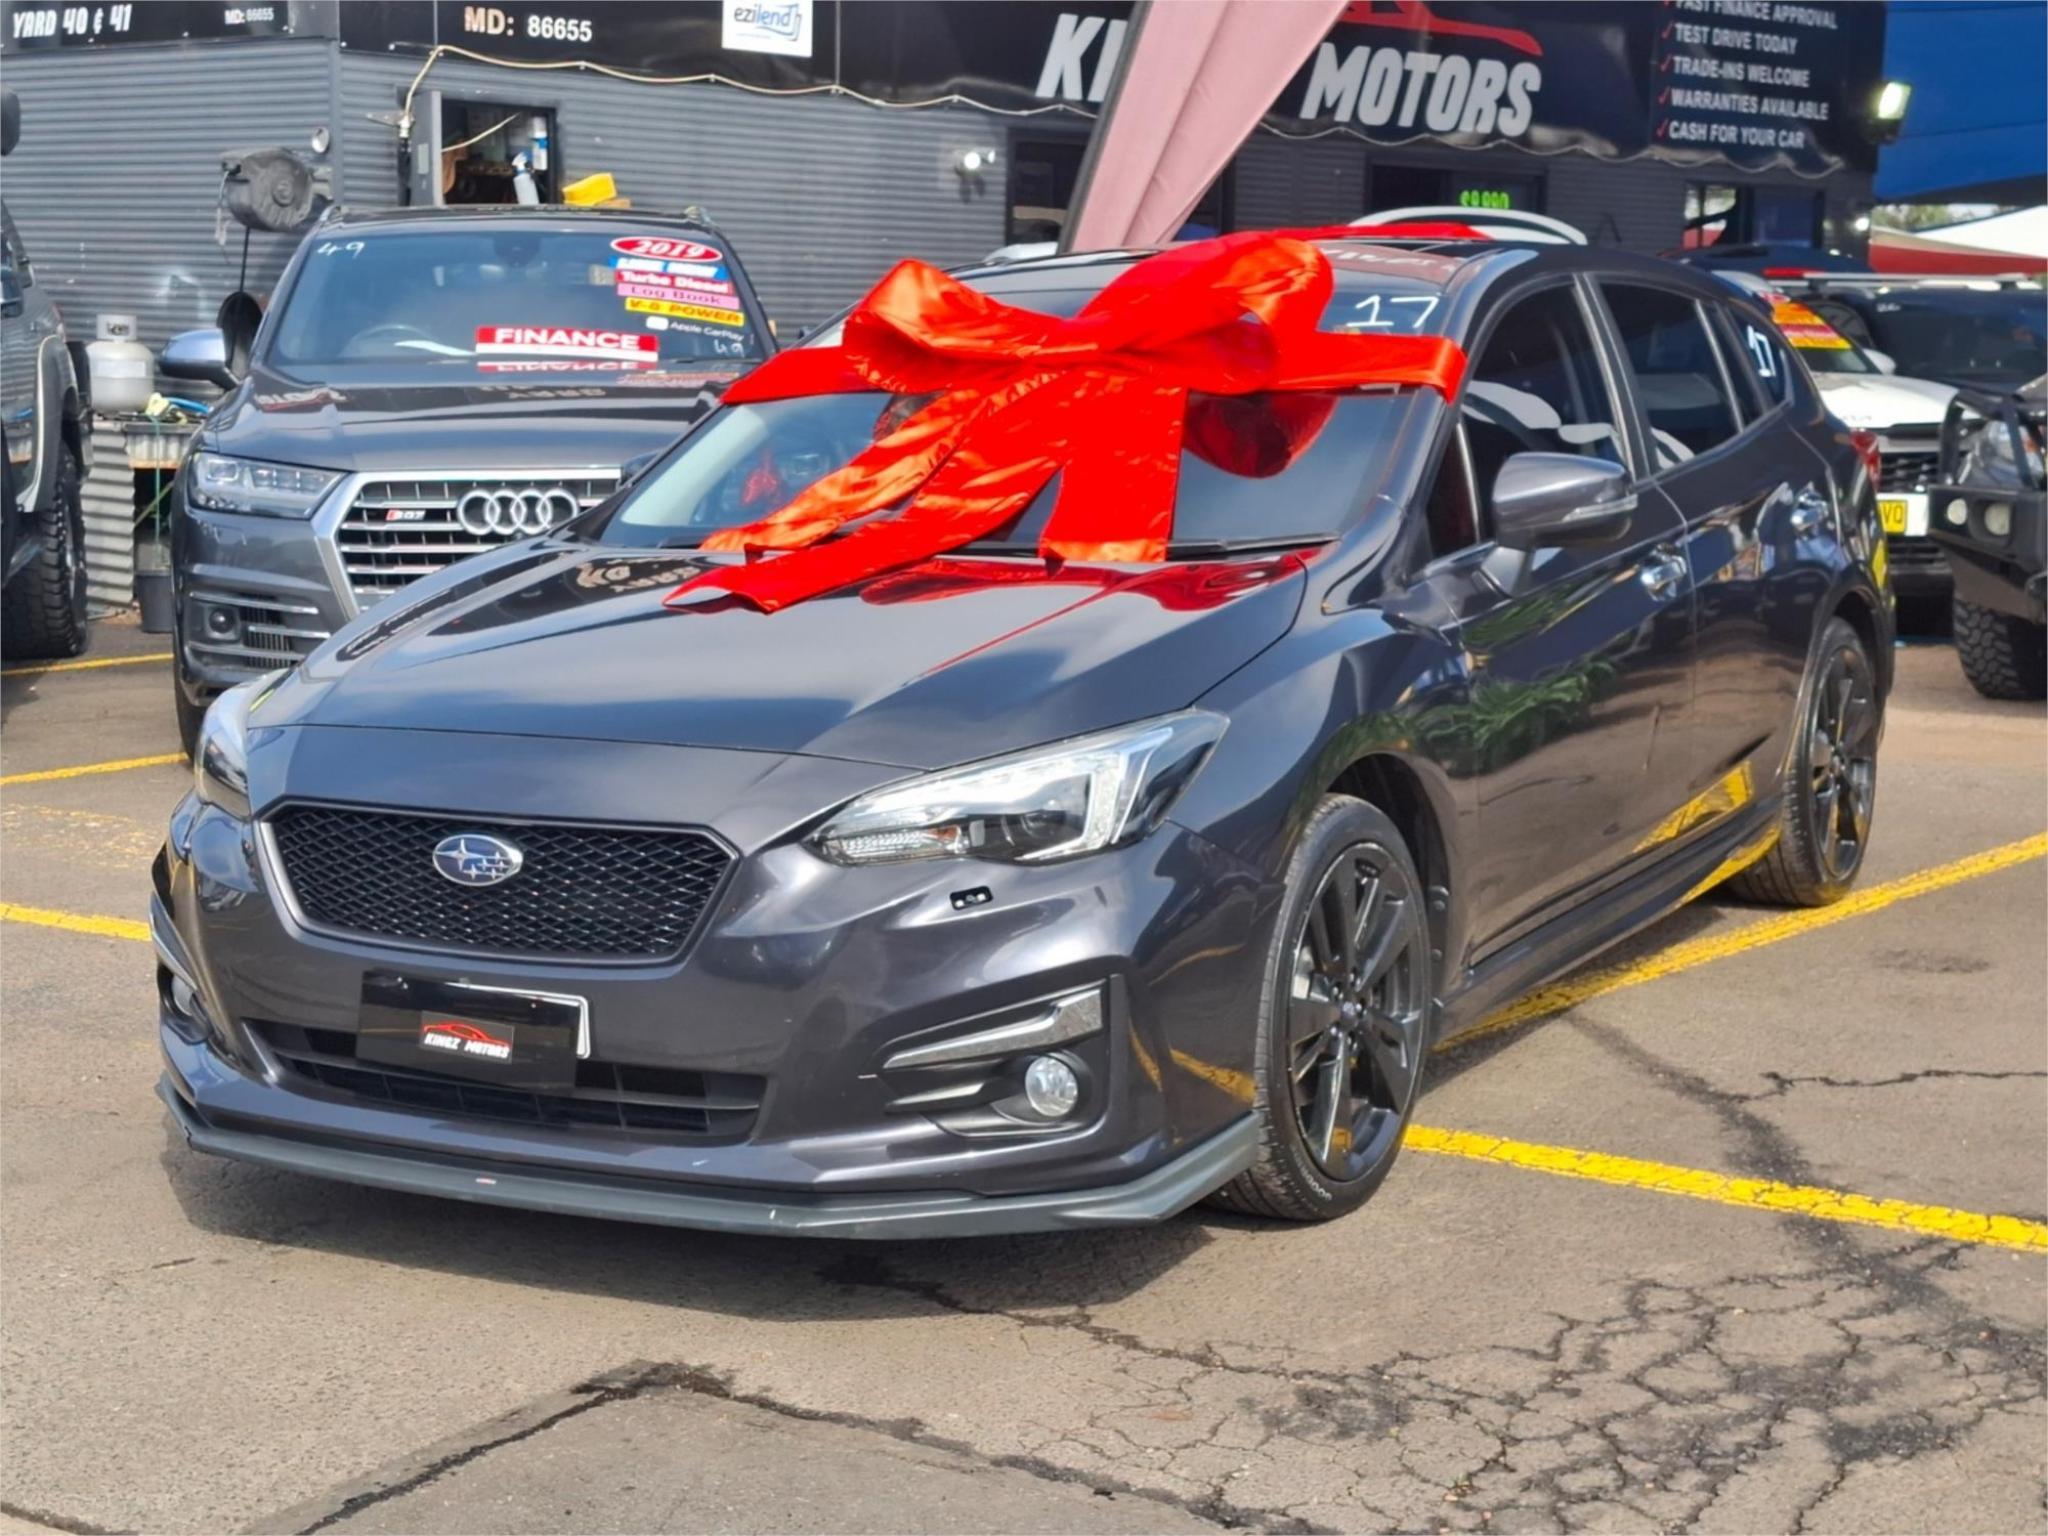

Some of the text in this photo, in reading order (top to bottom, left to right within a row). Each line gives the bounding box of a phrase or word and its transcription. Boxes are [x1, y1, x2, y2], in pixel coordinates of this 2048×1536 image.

[13, 10, 57, 38] YARD
[62, 8, 88, 35] 40
[109, 4, 132, 31] 41
[464, 6, 592, 42] MD: 86655
[734, 3, 791, 27] ezilend
[1713, 1, 1770, 20] FINANCE
[1772, 5, 1837, 29] APPROVAL
[1675, 23, 1798, 55] TEST DRIVE TODAY
[1035, 13, 1542, 137] KI MOTORS
[1673, 56, 1810, 87] TRADE-INS WELCOME
[1671, 88, 1829, 120] WARRANTIES AVAILABLE
[1669, 121, 1805, 149] CASH FOR YOUR CAR
[632, 240, 706, 258] 2019
[621, 271, 729, 294] Turbo Diesel
[631, 287, 721, 305] Log Book
[668, 302, 740, 323] POWER
[1346, 295, 1440, 328] 17
[494, 328, 640, 350] FINANCE
[670, 321, 745, 342] Apple CarPlay
[464, 1040, 510, 1059] MOTORS
